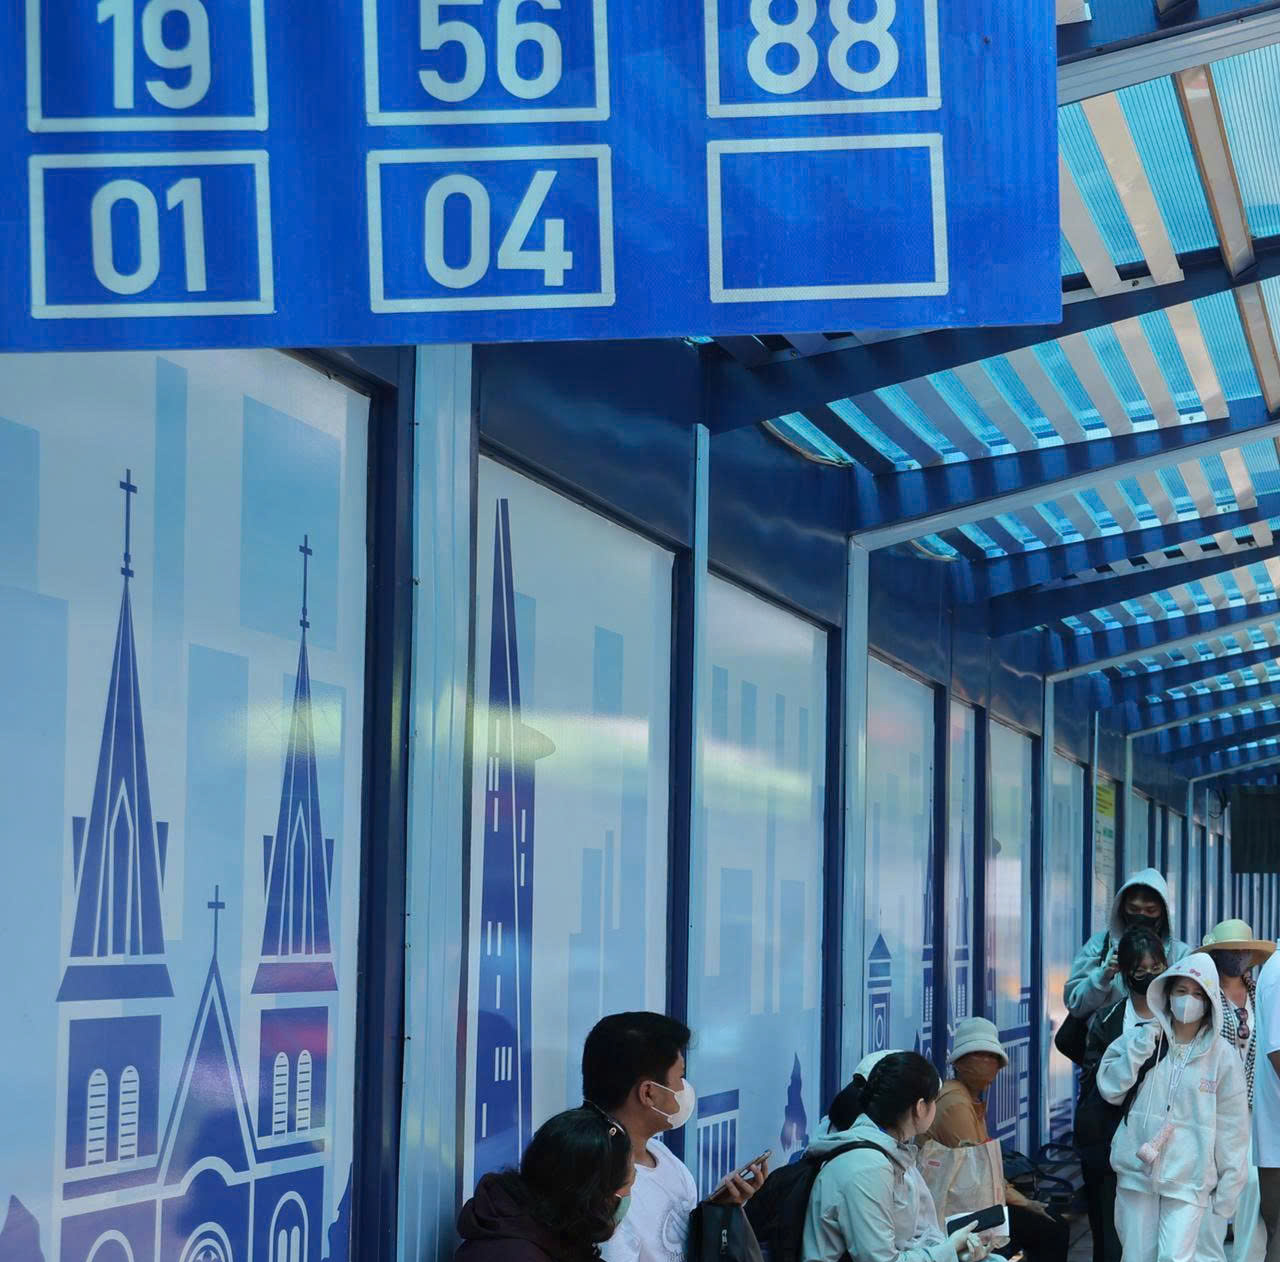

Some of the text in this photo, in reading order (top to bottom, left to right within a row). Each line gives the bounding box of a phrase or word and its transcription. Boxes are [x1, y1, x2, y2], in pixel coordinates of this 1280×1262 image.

[97, 0, 211, 109] 19
[418, 0, 564, 102] 56
[746, 0, 900, 95] 88
[90, 178, 209, 295] 01
[423, 170, 573, 289] 04
